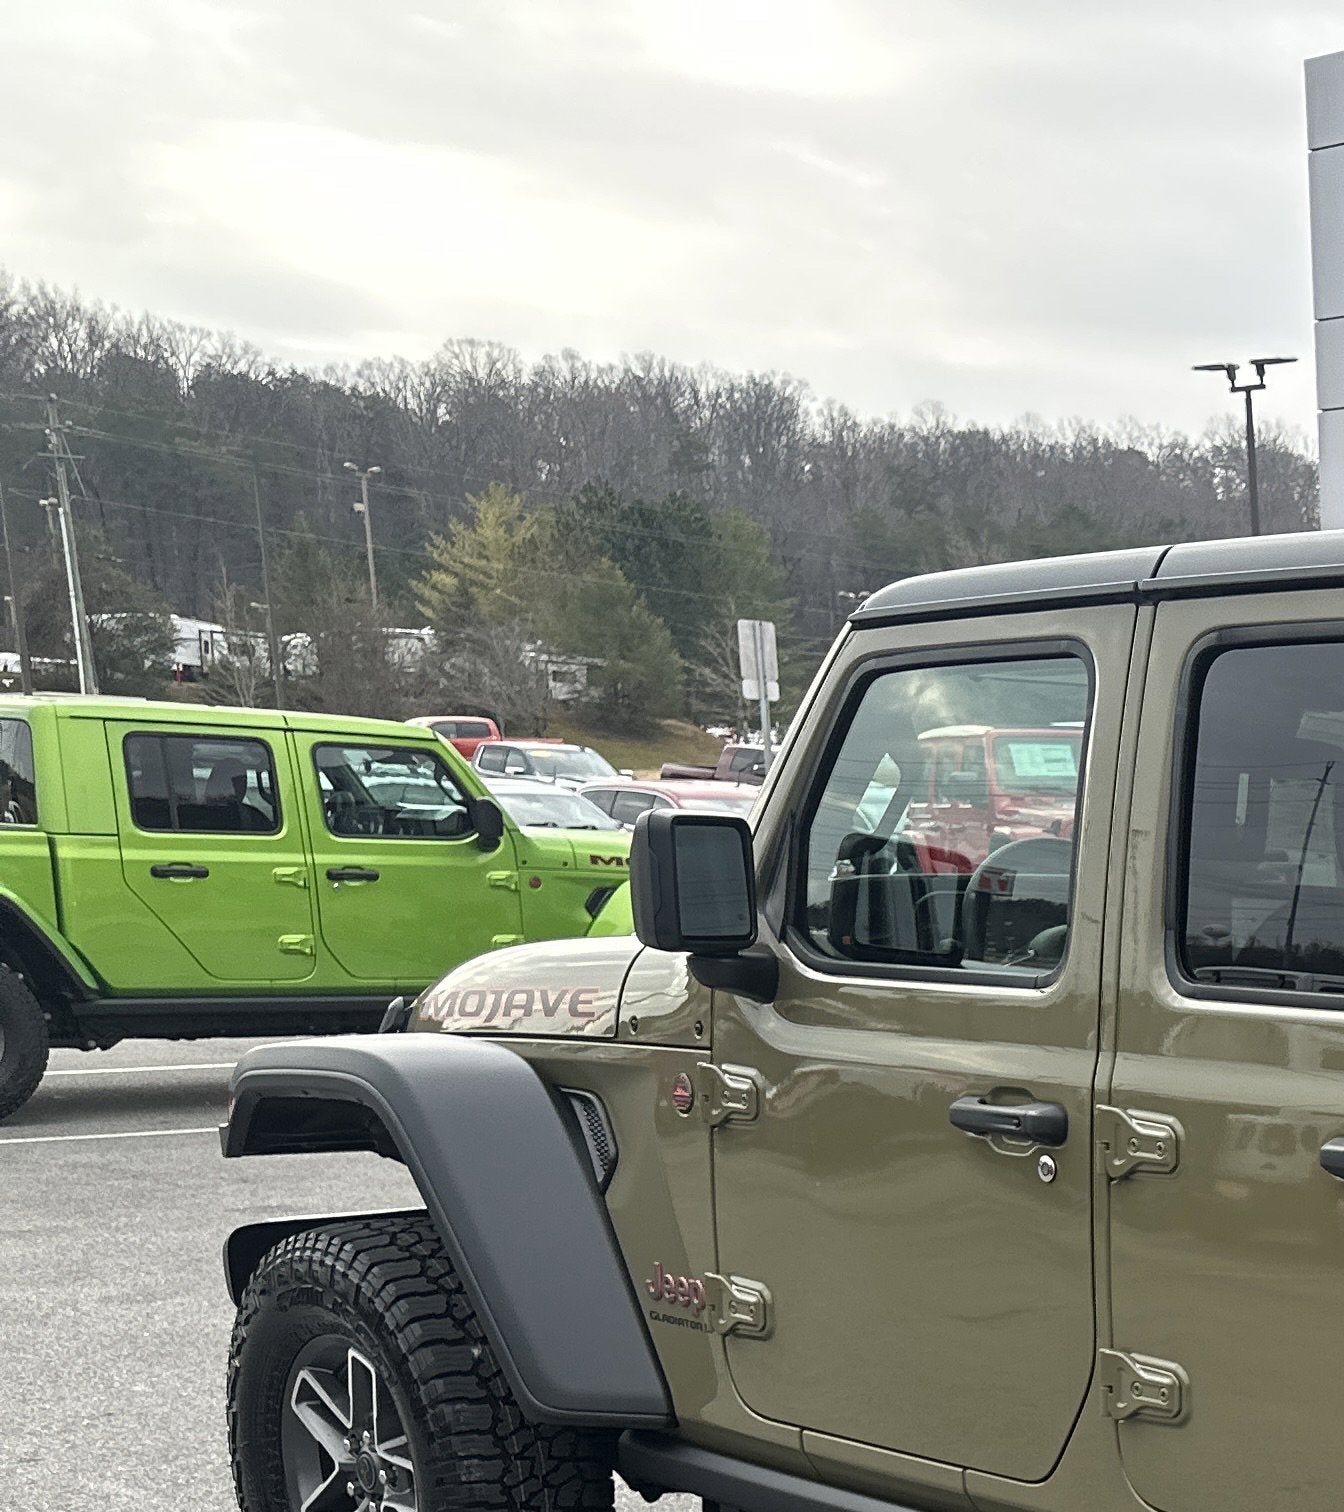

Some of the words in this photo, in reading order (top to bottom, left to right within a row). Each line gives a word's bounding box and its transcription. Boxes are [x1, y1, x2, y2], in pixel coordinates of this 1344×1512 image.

[420, 986, 600, 1024] MOJAVE
[646, 1261, 706, 1318] Jeep
[649, 1310, 704, 1332] GLADIATOR
